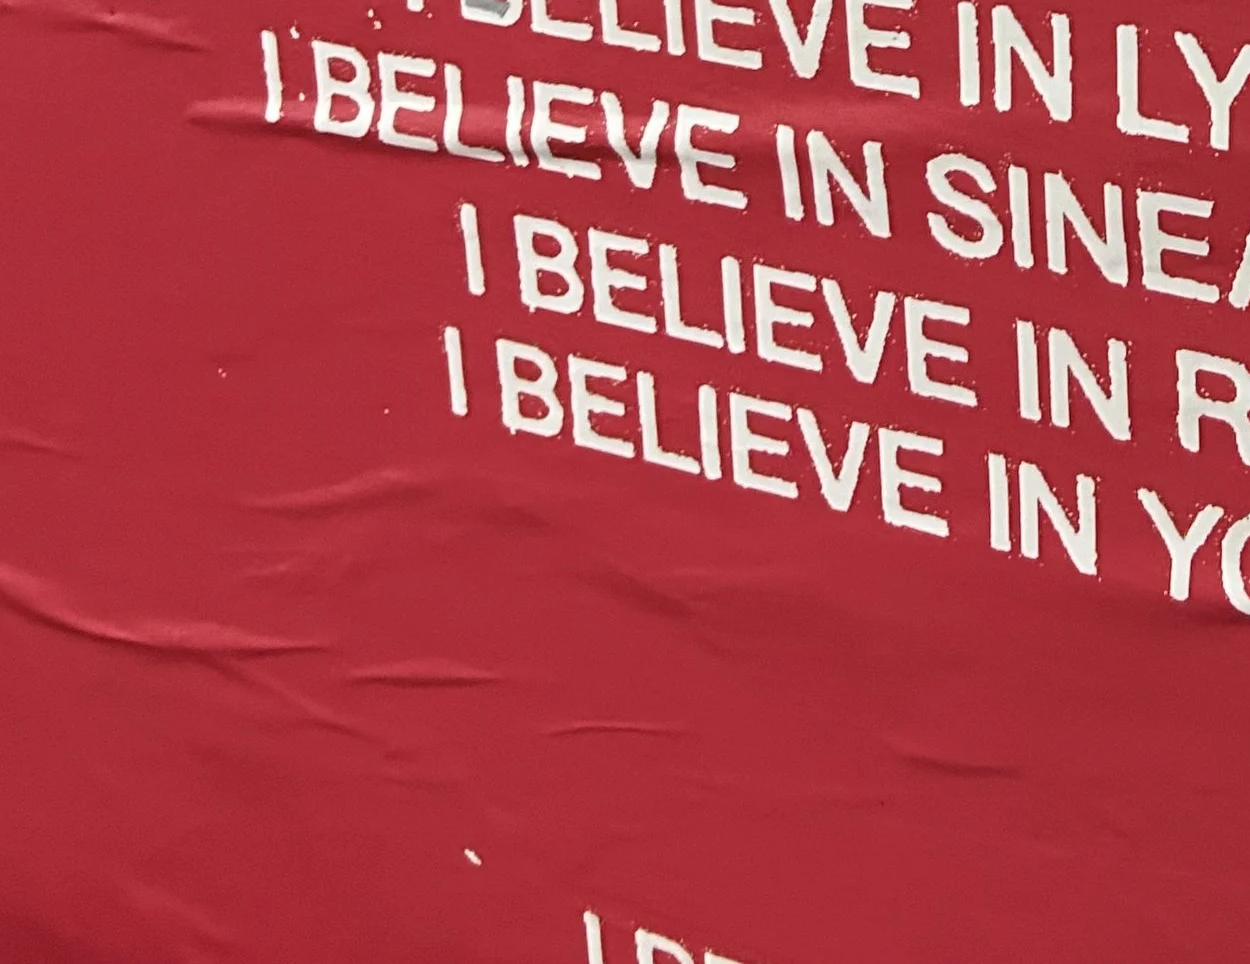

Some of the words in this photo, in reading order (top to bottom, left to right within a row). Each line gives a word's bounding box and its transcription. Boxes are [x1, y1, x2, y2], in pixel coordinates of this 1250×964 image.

[261, 30, 283, 123] I
[311, 40, 748, 209] BELIEVE
[776, 124, 891, 238] IN
[958, 1, 1072, 122] IN
[460, 203, 485, 296] I
[513, 214, 977, 407] BELIEVE
[1017, 320, 1131, 441] IN
[444, 326, 468, 416] I
[496, 339, 949, 537] BELIEVE
[988, 453, 1097, 575] IN
